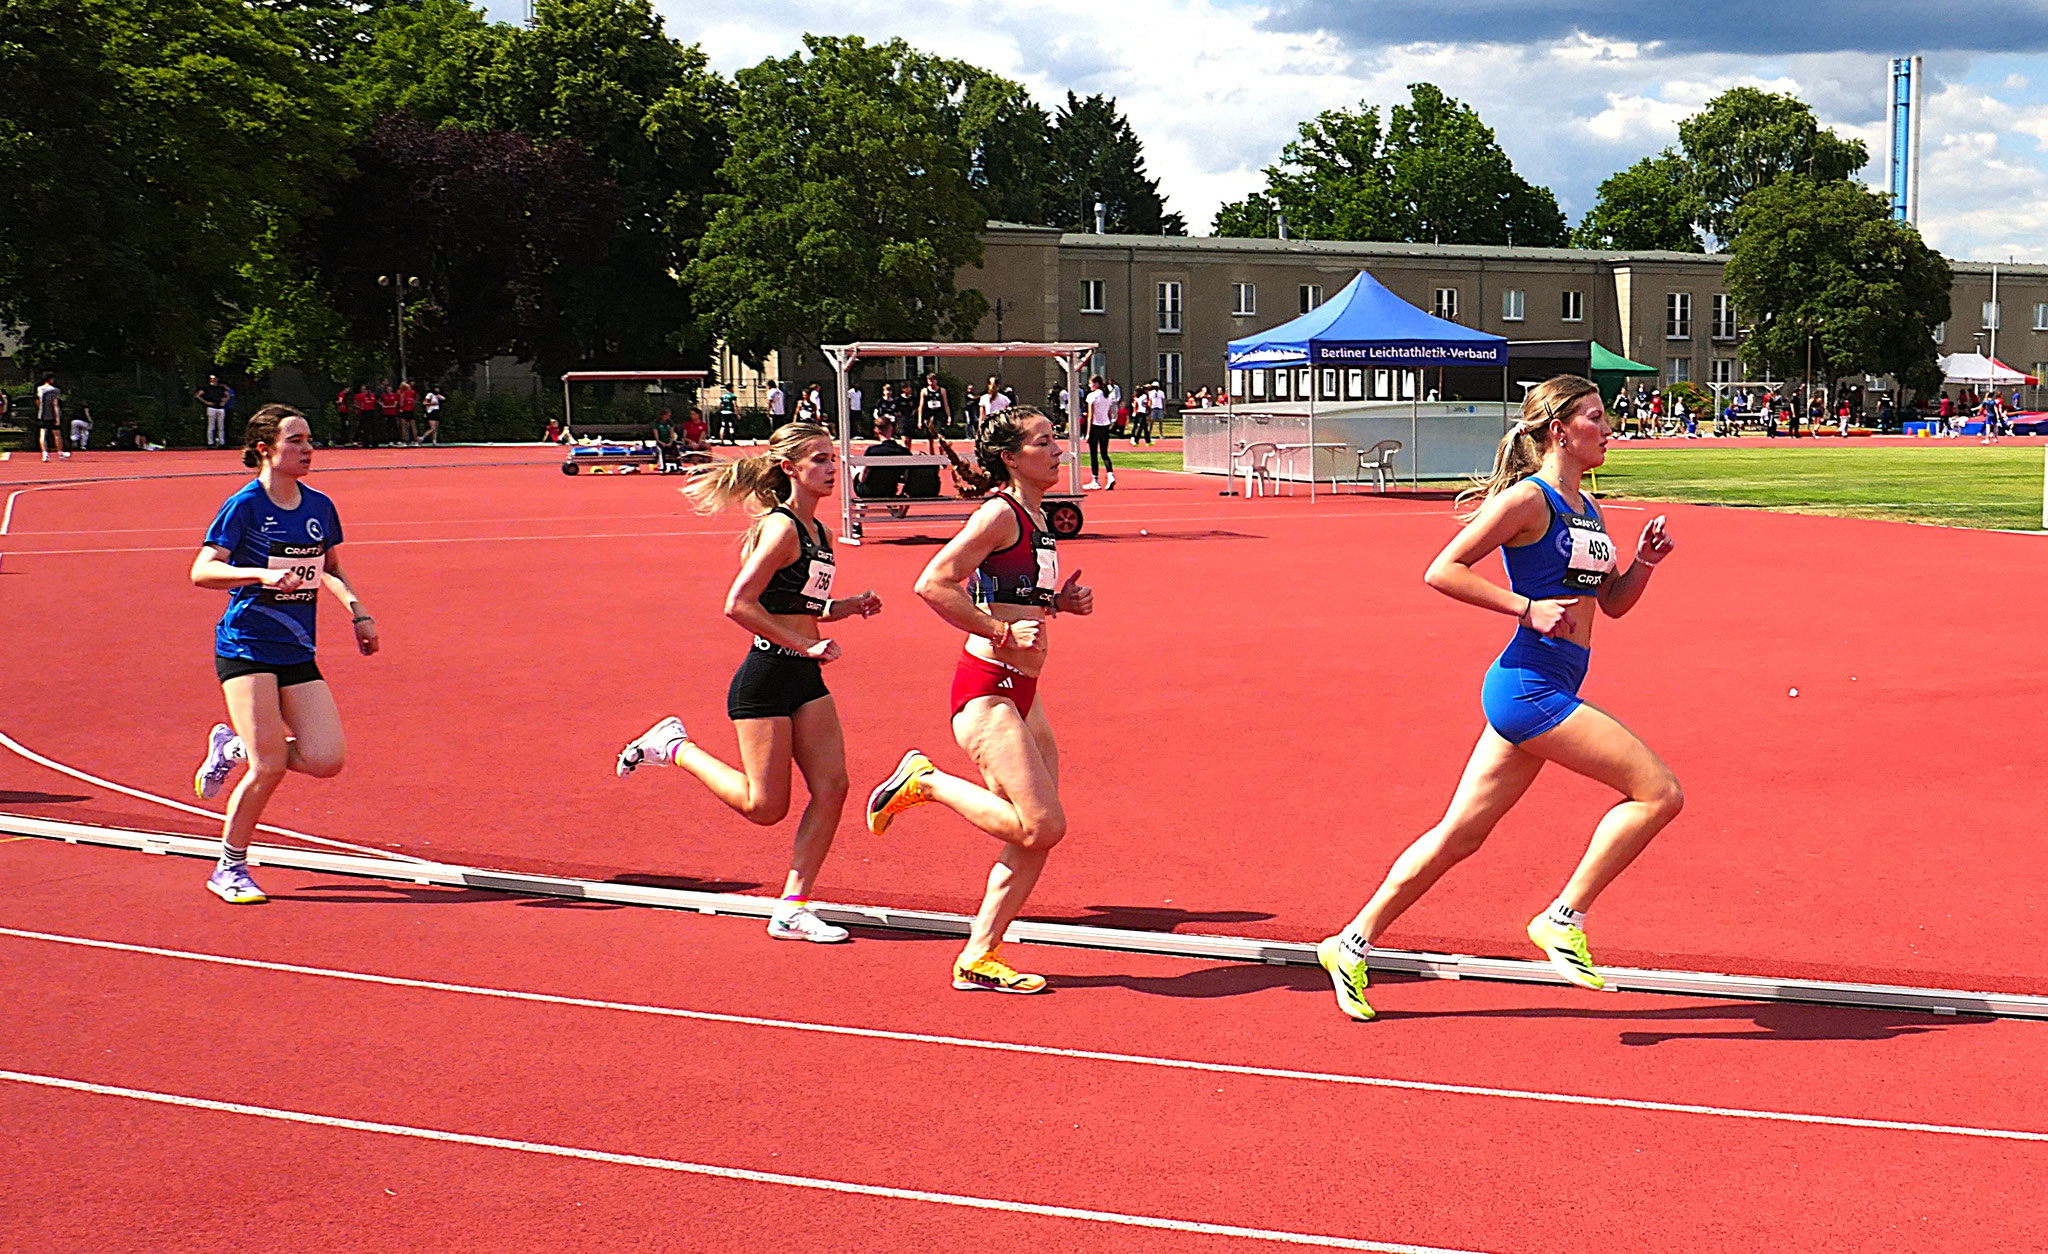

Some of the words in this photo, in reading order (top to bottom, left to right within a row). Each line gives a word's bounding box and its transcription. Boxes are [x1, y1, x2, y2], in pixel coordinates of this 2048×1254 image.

[1321, 347, 1366, 358] Berliner
[1369, 346, 1497, 360] Leichtathletik-Verband
[284, 546, 316, 555] CRAFT
[1589, 539, 1609, 562] 493
[814, 571, 832, 591] 756
[275, 592, 307, 601] CRAFT
